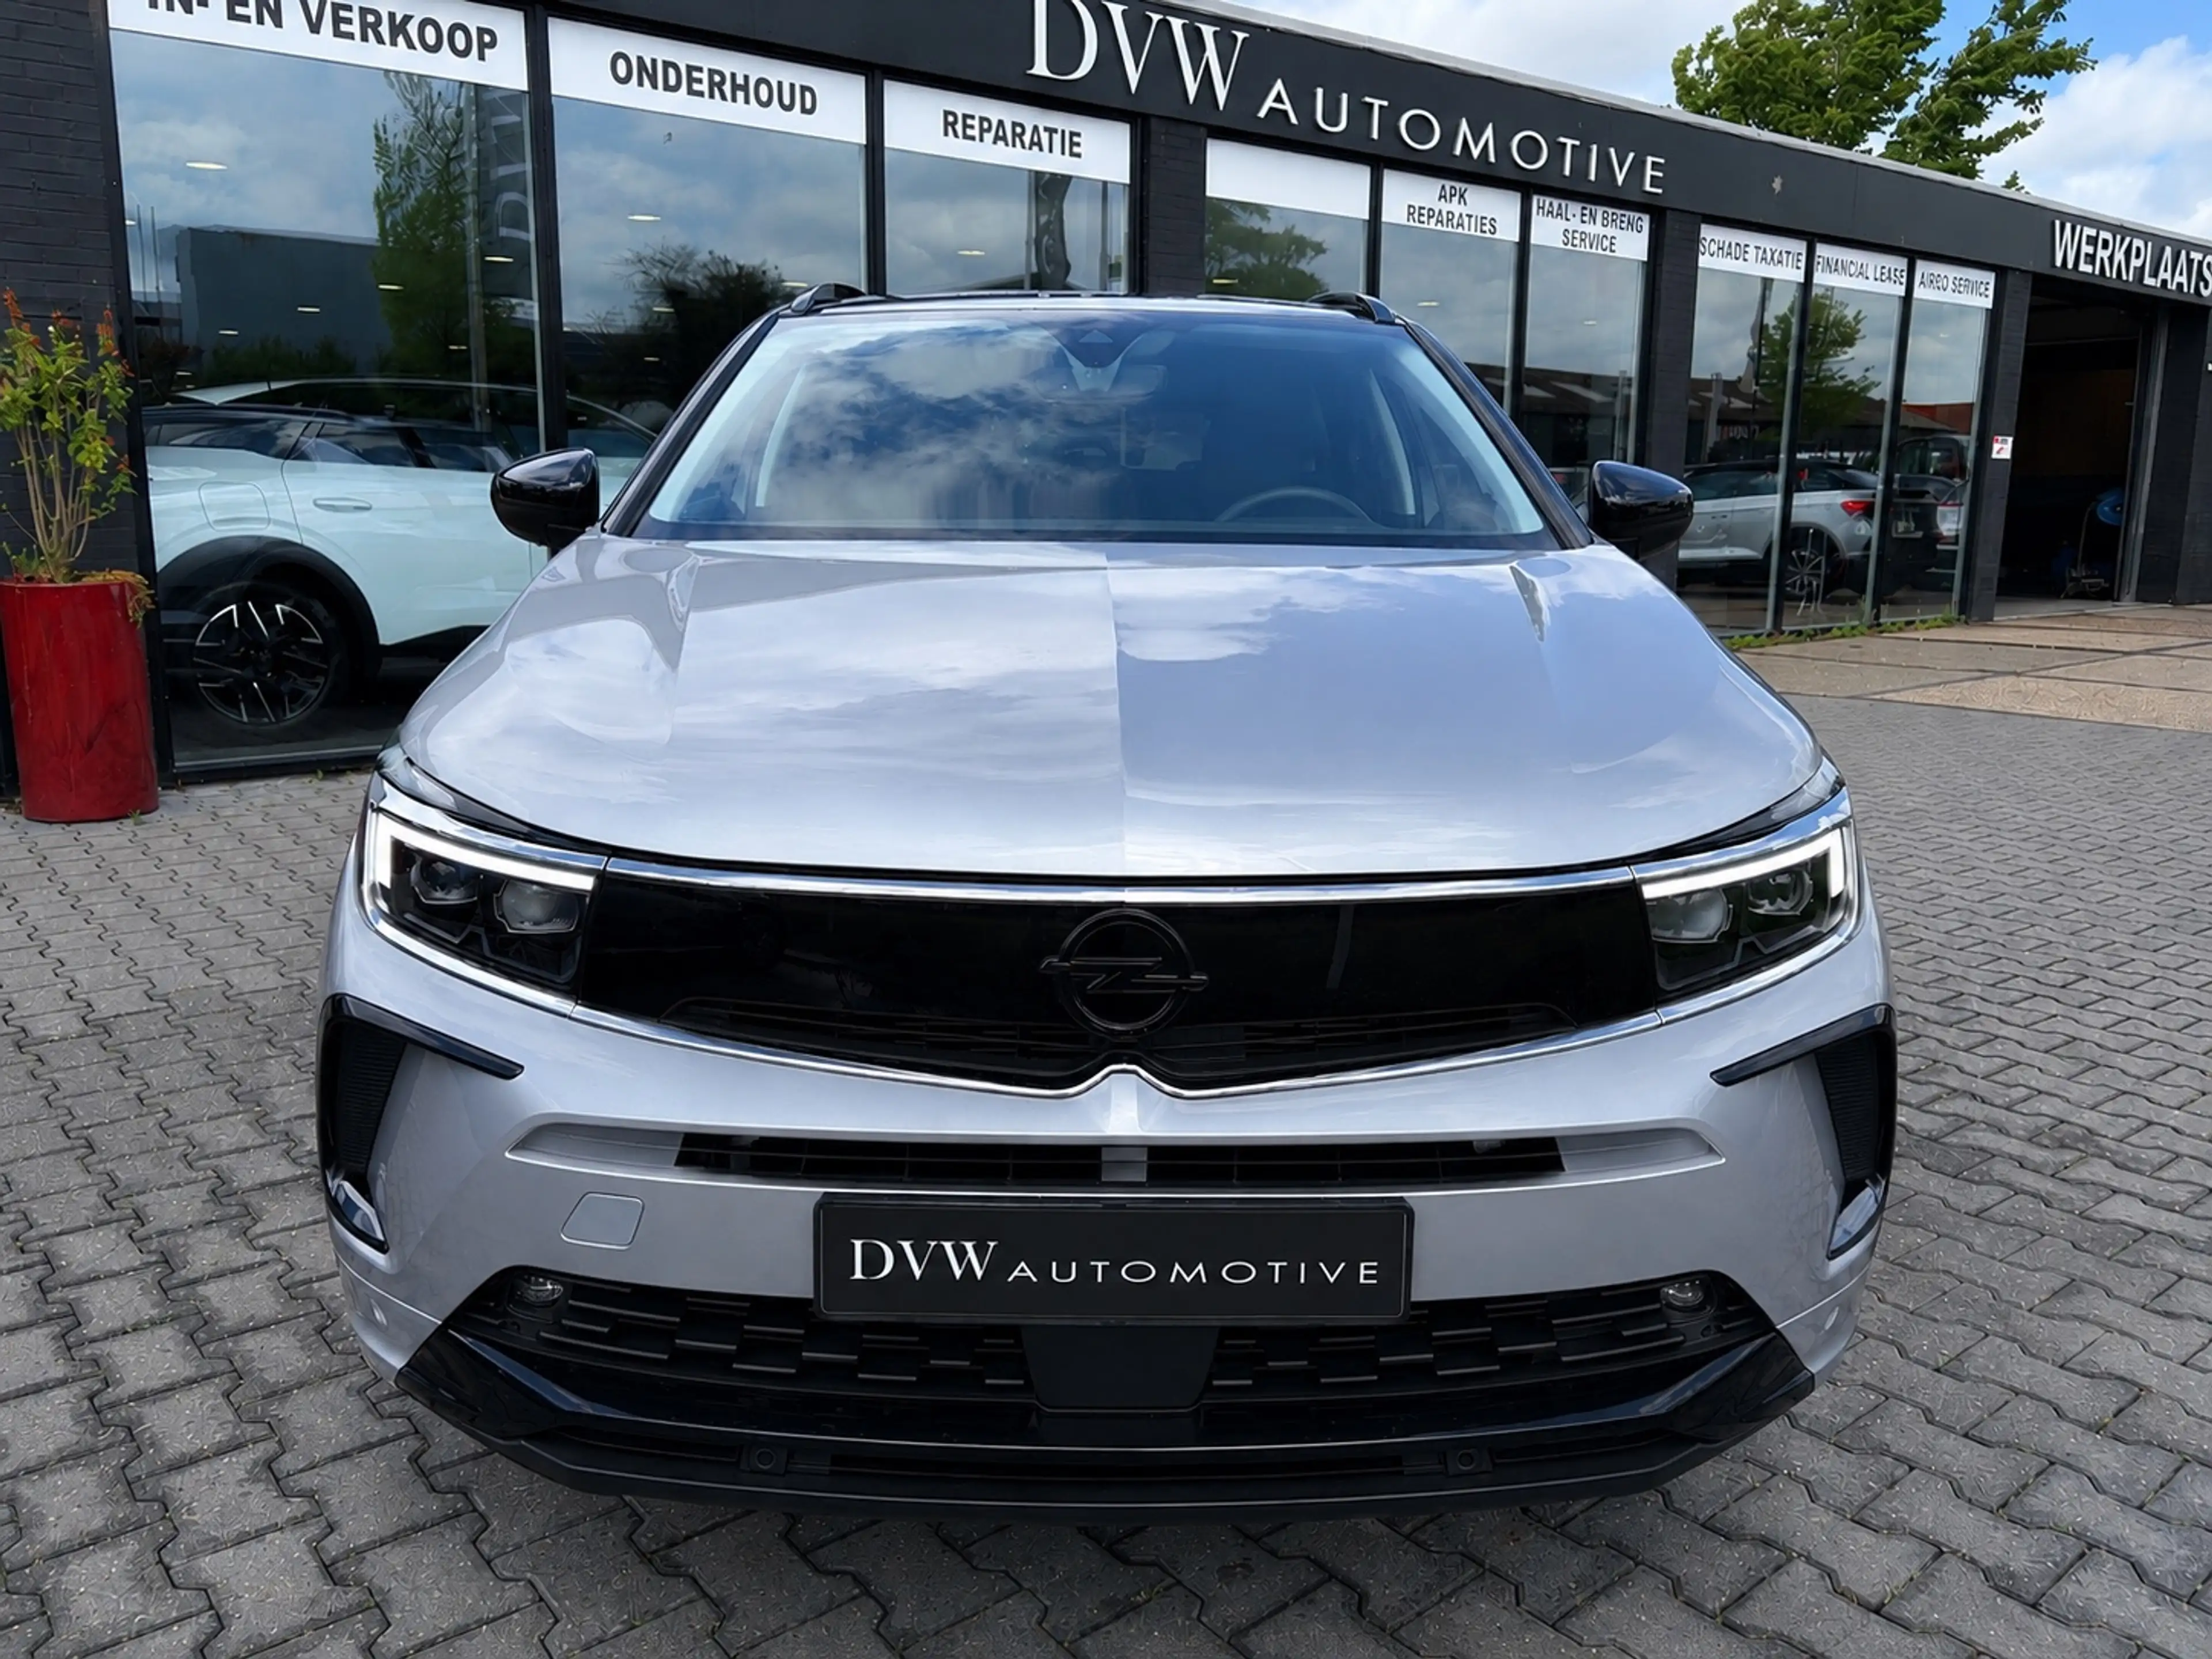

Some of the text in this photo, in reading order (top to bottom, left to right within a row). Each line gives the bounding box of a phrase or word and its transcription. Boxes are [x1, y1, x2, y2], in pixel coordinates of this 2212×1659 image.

[226, 0, 498, 62] EN VERKOOP
[609, 51, 819, 116] ONDERHOUD
[1027, 0, 1667, 196] DVW AUTOMOTIVE
[942, 109, 1083, 158] REPARATIE
[1437, 184, 1468, 206] APK
[1407, 203, 1497, 235] REPARATIES
[1536, 198, 1644, 233] HAAL- EN BRENG
[1562, 228, 1617, 253] SERVICE
[1700, 236, 1803, 270] SCHADE TAXATIE
[1816, 255, 1906, 286] FINANCIAL LEASE
[2054, 219, 2212, 298] WERKPLAATS
[1951, 276, 1990, 298] SERVICE
[850, 1238, 1378, 1284] DVW AUTOMOTIVE
